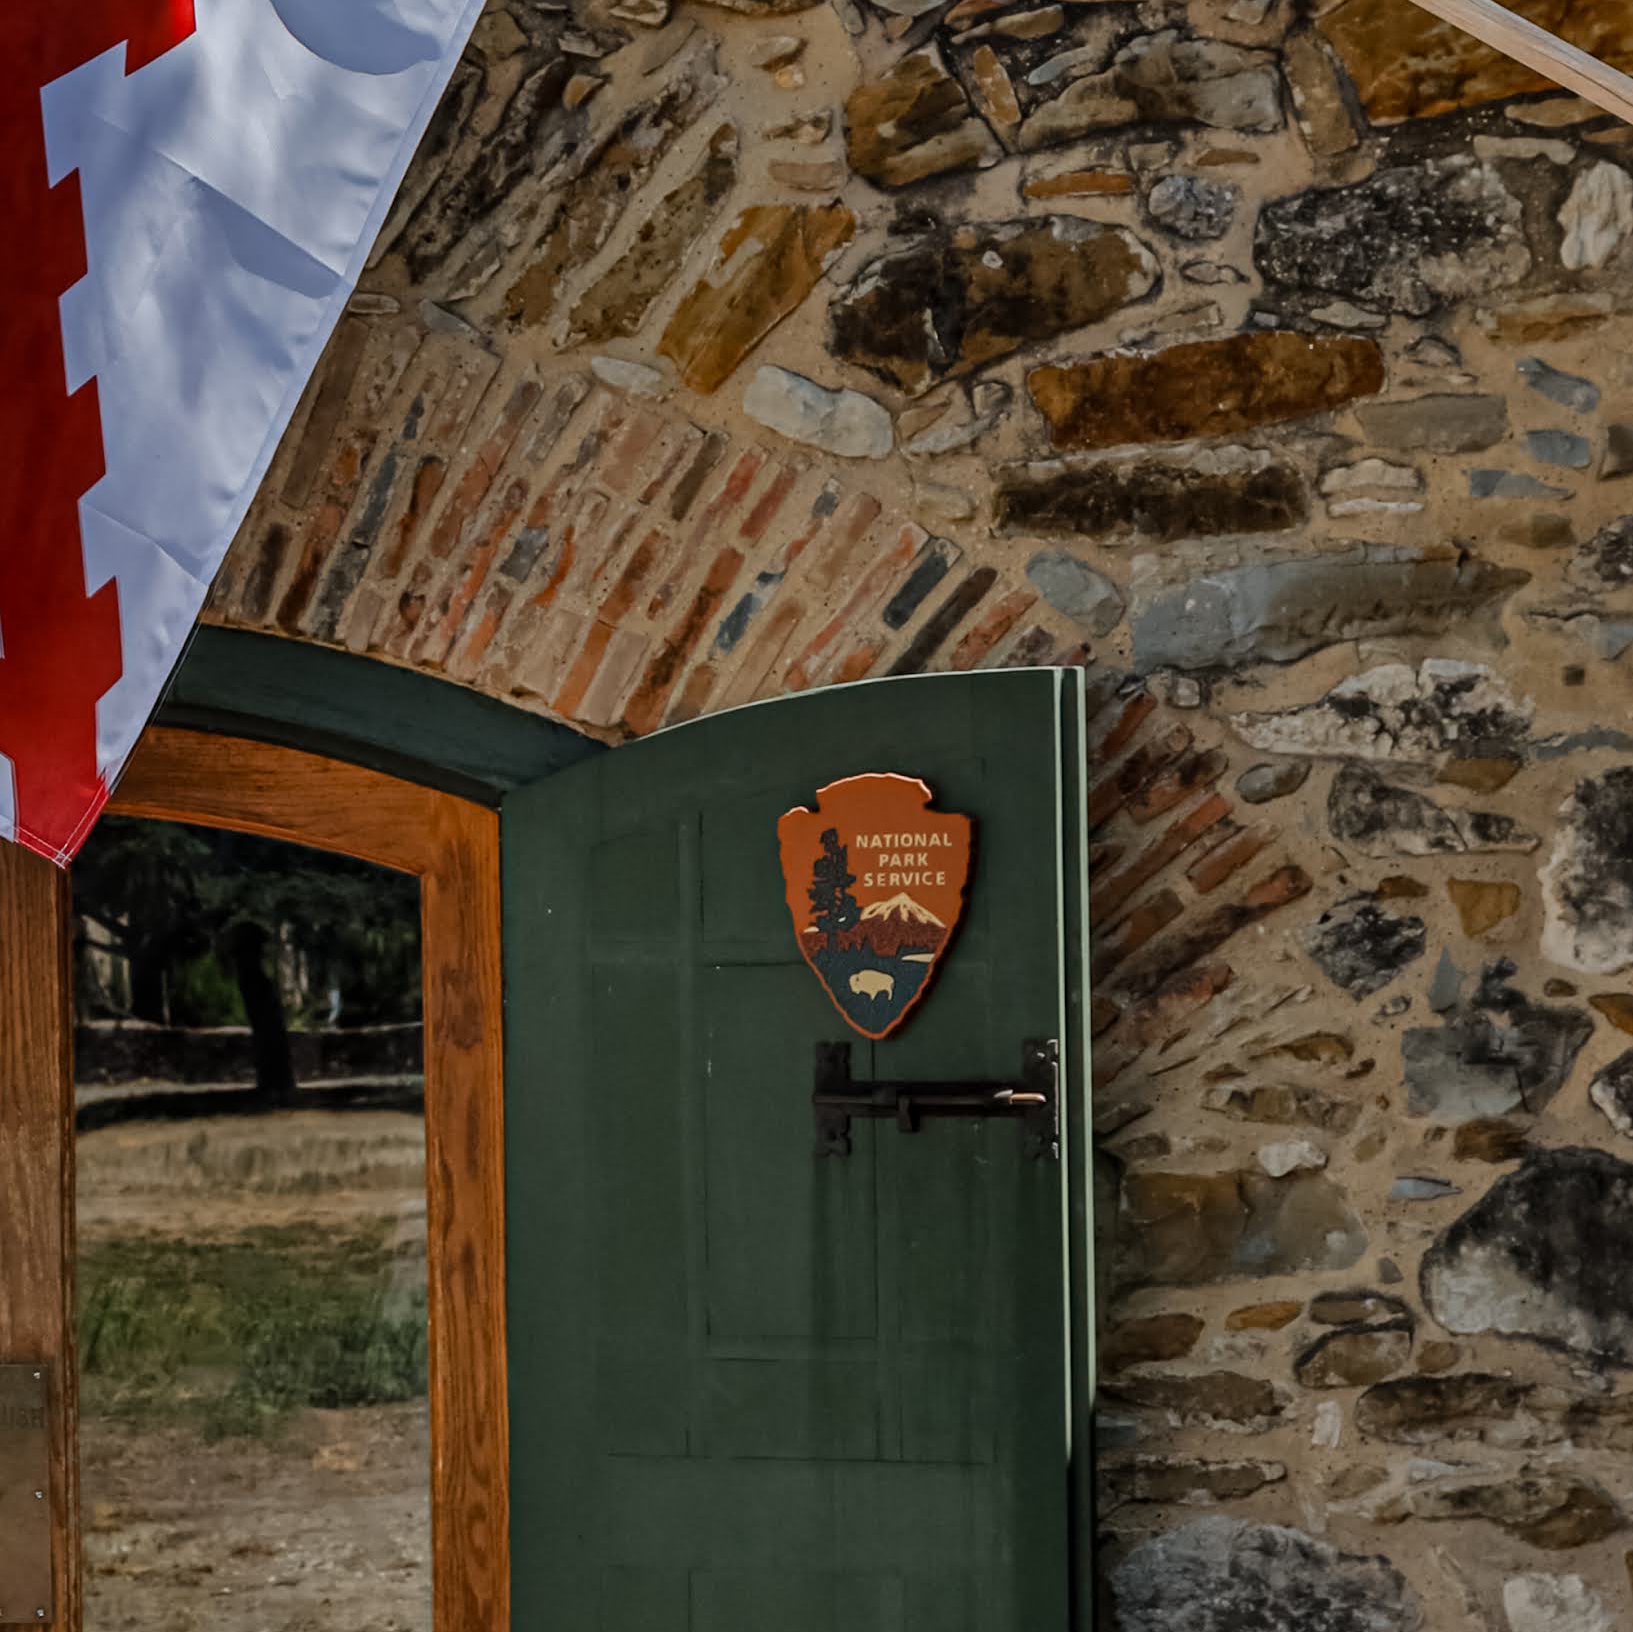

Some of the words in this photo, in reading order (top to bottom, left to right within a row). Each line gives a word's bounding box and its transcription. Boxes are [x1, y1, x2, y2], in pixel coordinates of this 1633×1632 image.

[856, 833, 953, 848] NATIONAL
[879, 853, 929, 867] PARK
[863, 871, 946, 887] SERVICE
